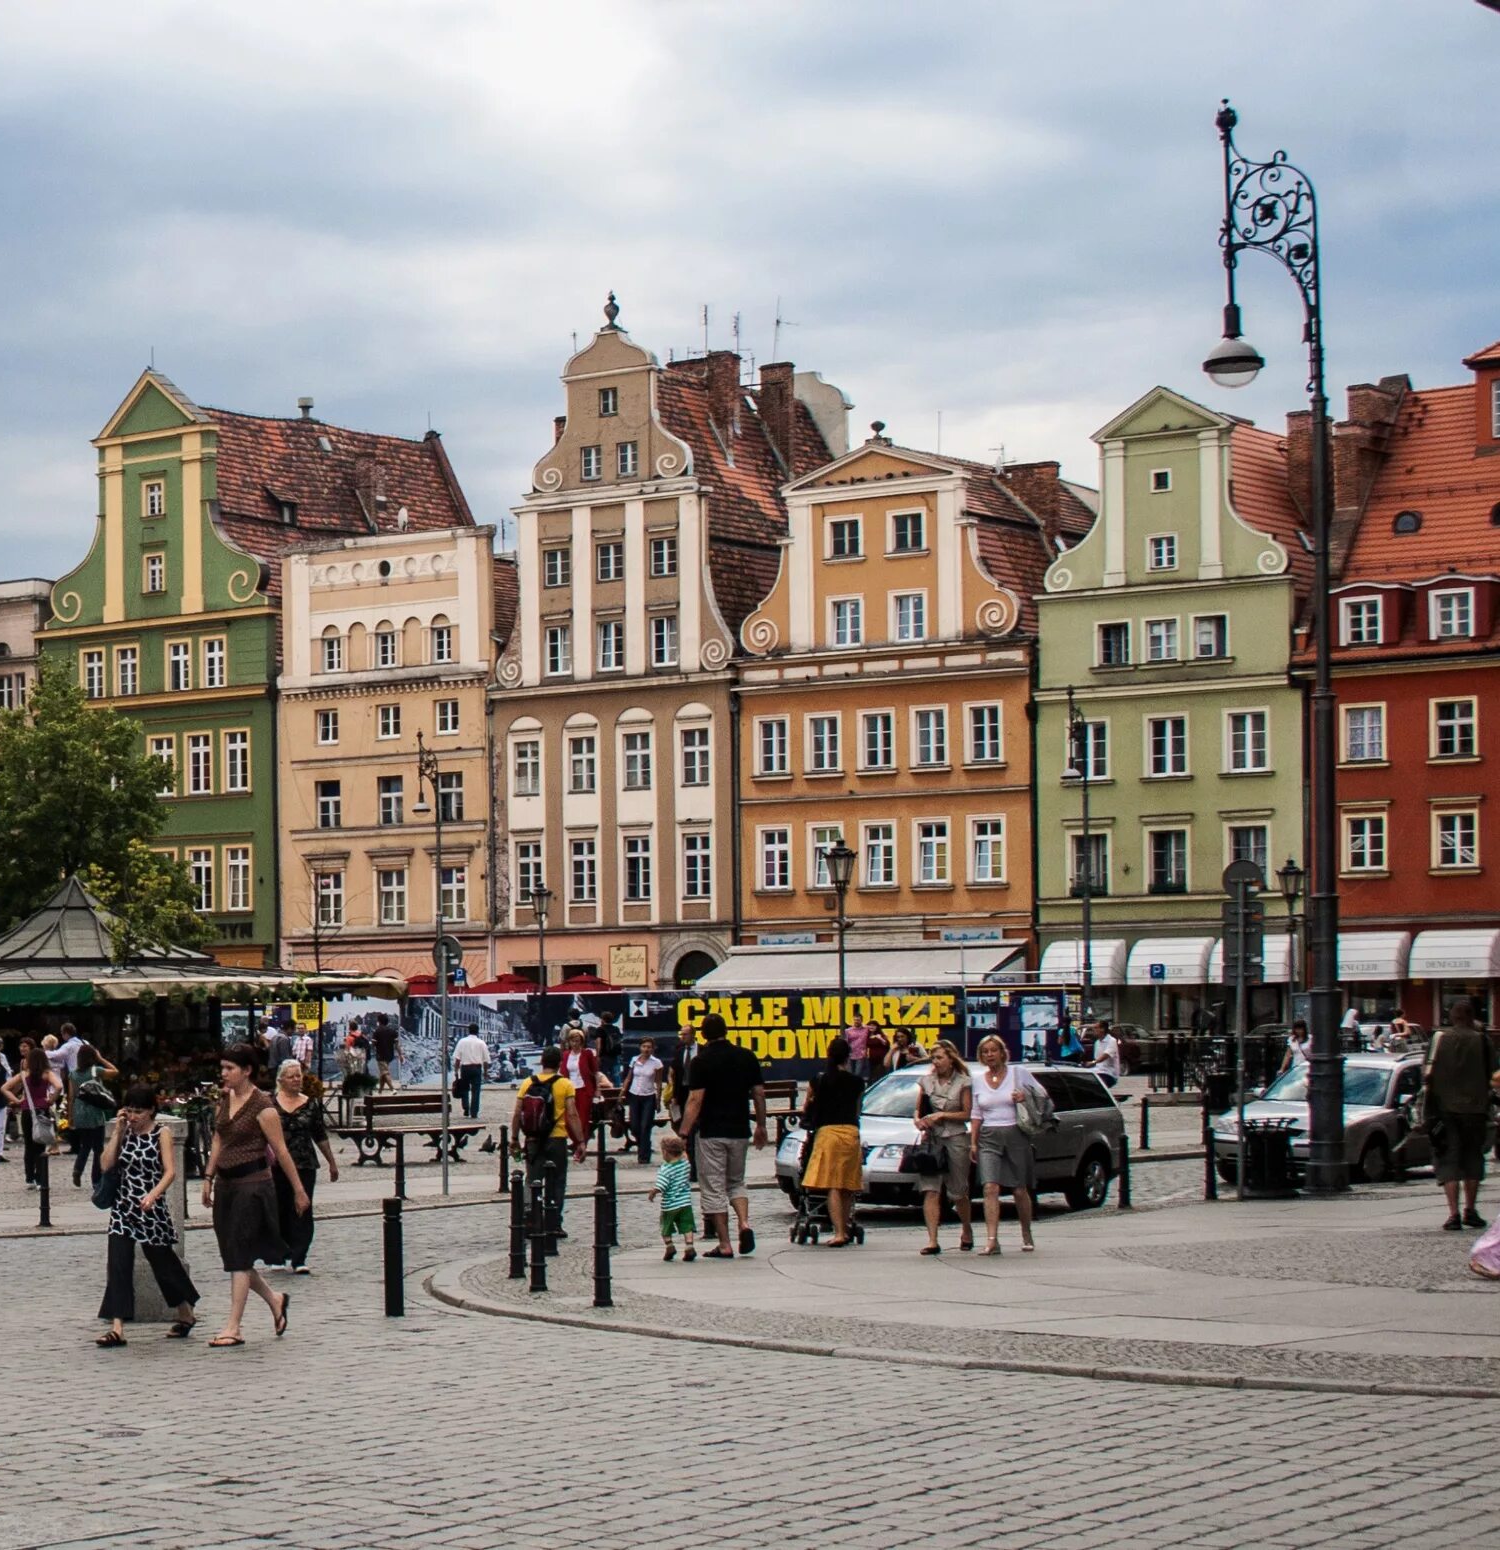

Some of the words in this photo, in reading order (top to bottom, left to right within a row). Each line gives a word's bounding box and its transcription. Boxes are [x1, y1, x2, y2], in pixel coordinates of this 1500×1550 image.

[456, 968, 463, 979] P
[615, 965, 642, 982] Lody
[1152, 965, 1162, 976] P
[677, 997, 789, 1028] CAŁE
[802, 995, 956, 1026] MORZE
